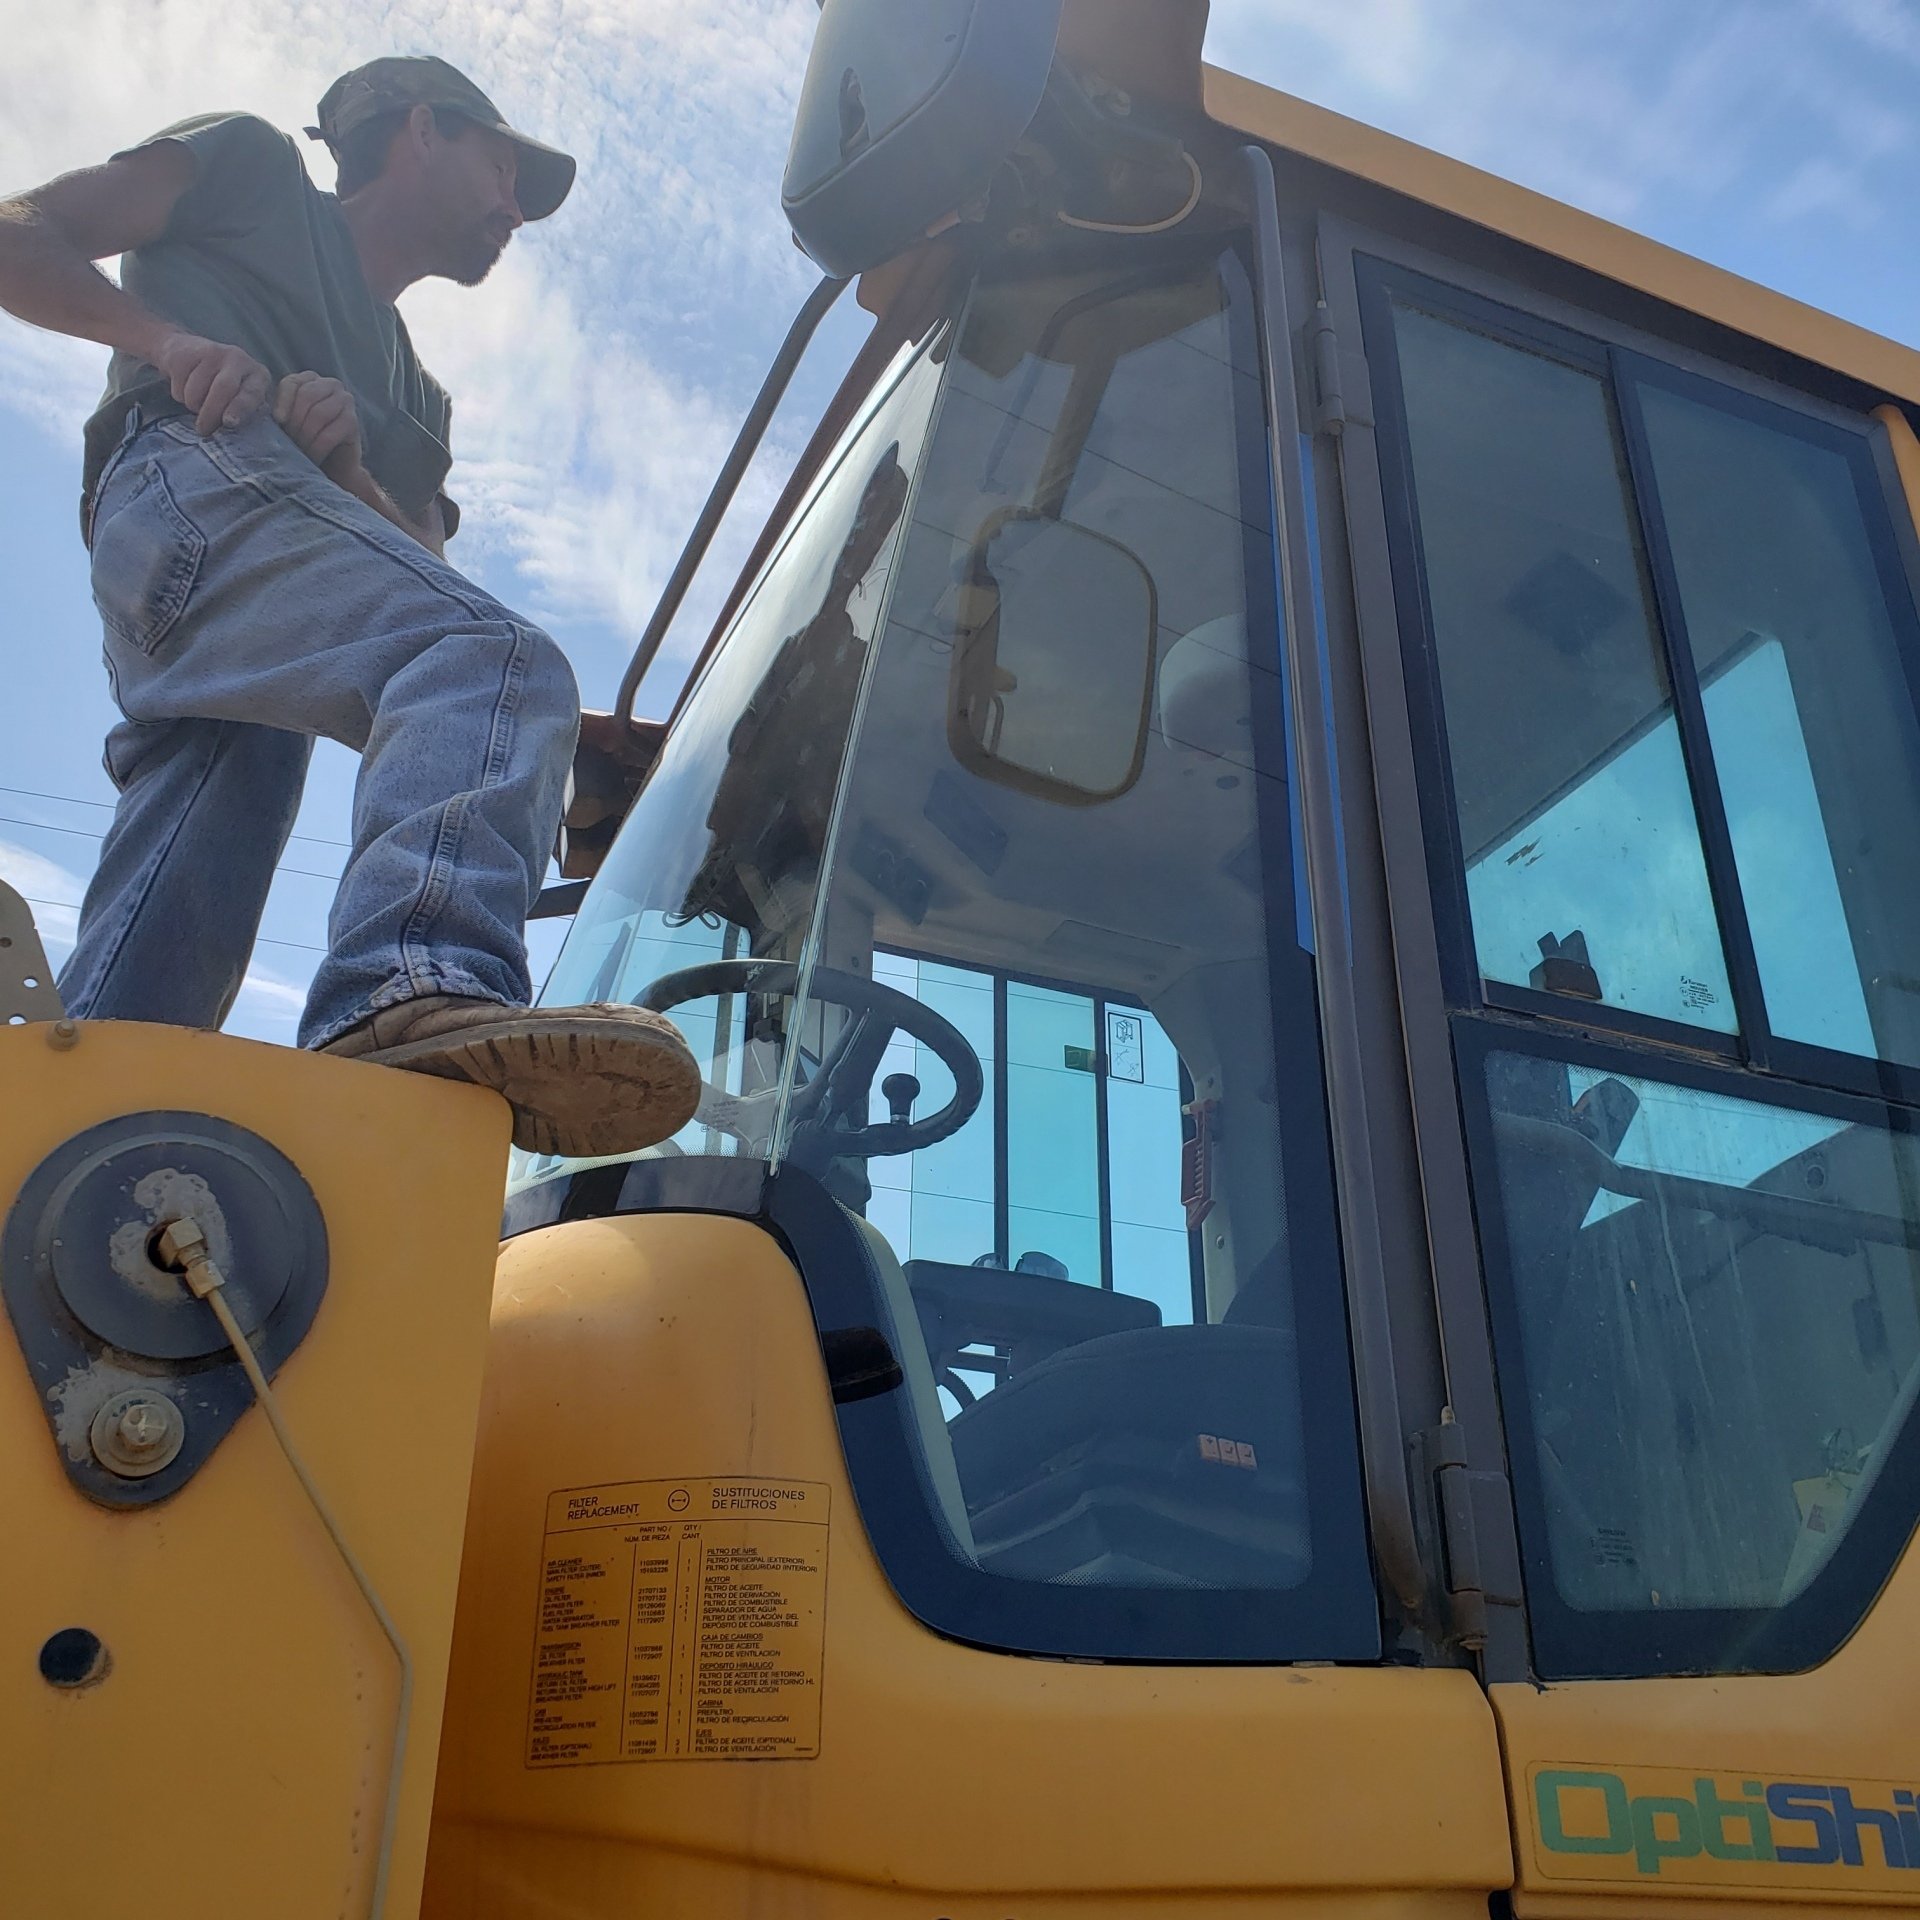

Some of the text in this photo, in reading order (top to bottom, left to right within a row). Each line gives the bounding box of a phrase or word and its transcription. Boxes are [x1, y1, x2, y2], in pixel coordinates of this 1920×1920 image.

[712, 1487, 805, 1500] SUSTITUCIONES
[568, 1496, 598, 1509] FILTER
[712, 1499, 777, 1510] DE FILTROS
[567, 1503, 640, 1520] REPLACEMENT
[1535, 1770, 1920, 1875] OptiShi
